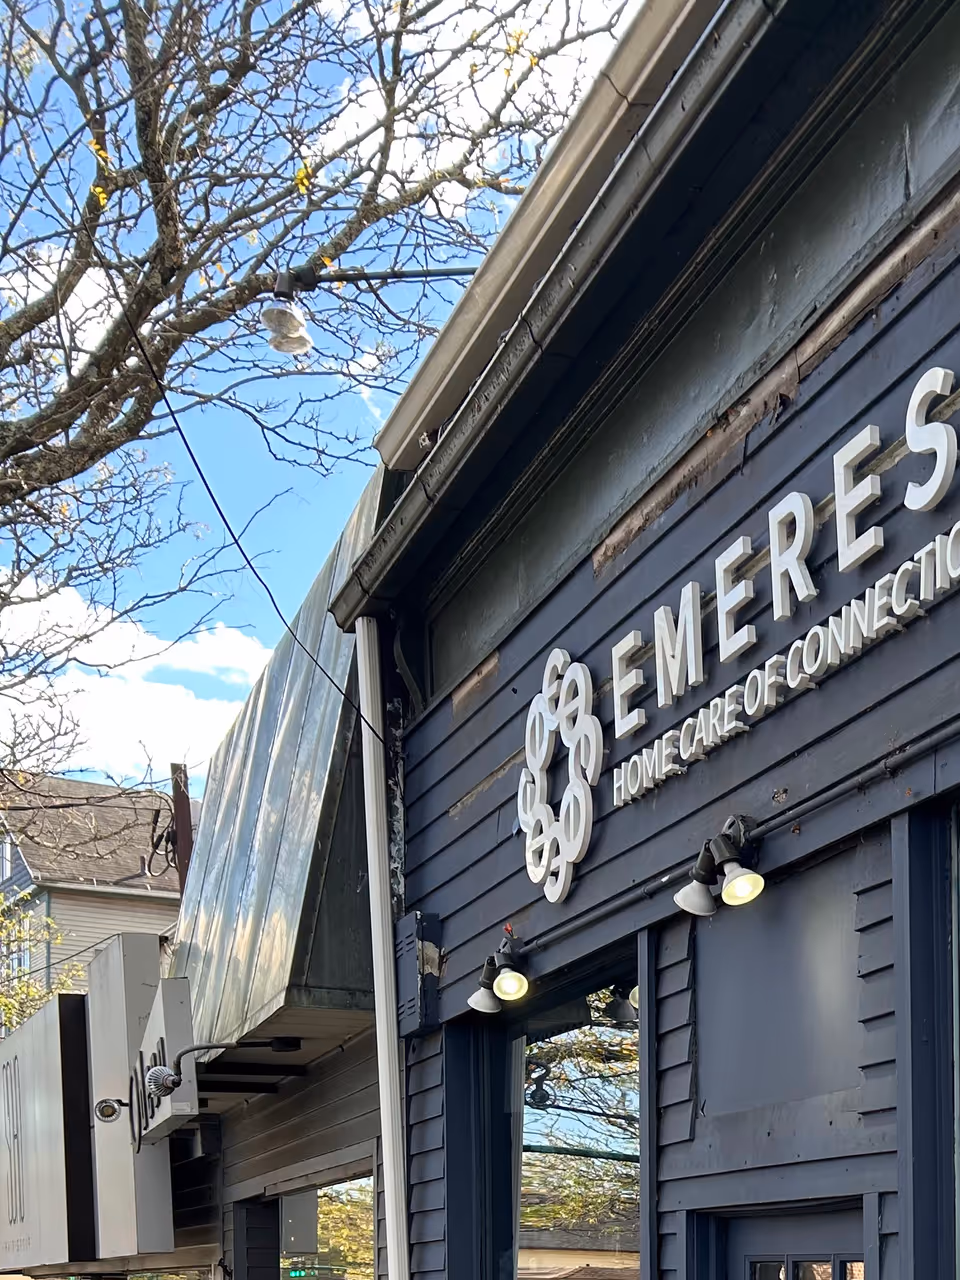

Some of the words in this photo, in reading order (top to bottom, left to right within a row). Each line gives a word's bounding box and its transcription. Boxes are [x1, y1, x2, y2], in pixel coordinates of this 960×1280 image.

[613, 730, 681, 807] HOME
[680, 684, 745, 760] CARE
[744, 654, 787, 716] OF
